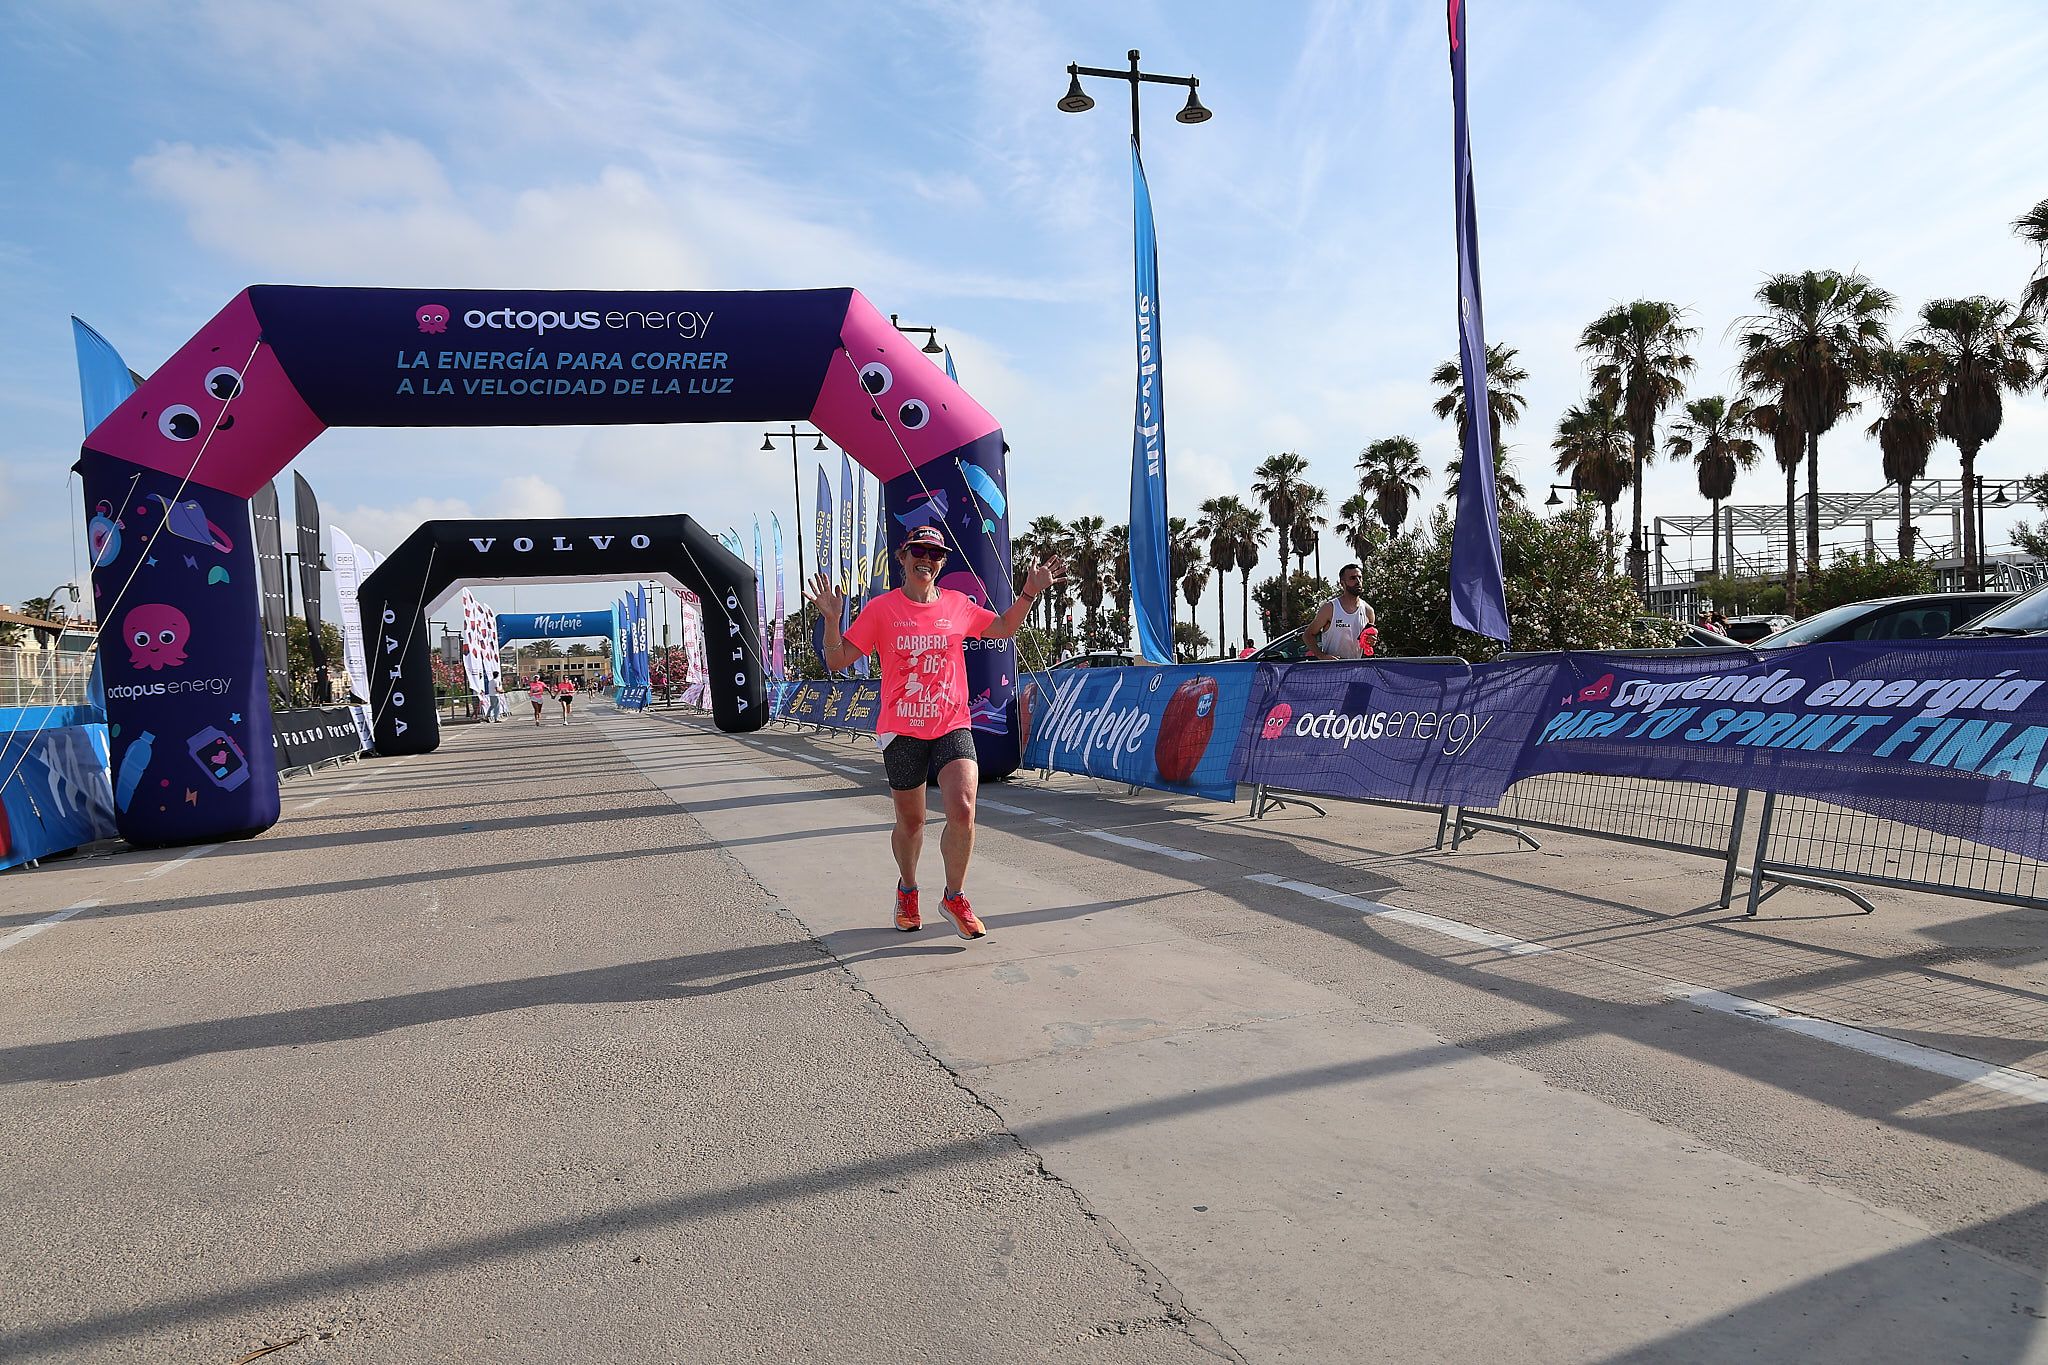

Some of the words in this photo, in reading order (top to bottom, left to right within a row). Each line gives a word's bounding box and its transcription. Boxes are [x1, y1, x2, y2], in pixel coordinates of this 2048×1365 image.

[464, 308, 600, 335] octopus
[605, 311, 713, 338] energy
[397, 351, 429, 369] LA
[438, 347, 549, 369] ENERGÍA
[556, 352, 623, 370] PARA
[631, 352, 728, 370] CORRER
[396, 378, 414, 394] A
[422, 378, 454, 394] LA
[463, 378, 606, 394] VELOCIDAD
[613, 379, 645, 394] DE
[651, 378, 680, 394] LA
[688, 377, 733, 394] LUZ
[468, 534, 651, 553] VOLVO
[534, 614, 582, 635] Marlene
[897, 635, 948, 650] CARRERA
[969, 638, 1008, 652] energy
[726, 595, 749, 714] VOLVO
[923, 655, 939, 674] DE
[382, 609, 408, 736] VOLVO
[108, 683, 166, 700] octopus
[167, 678, 232, 695] energy
[919, 689, 931, 703] LA
[1804, 669, 2046, 718] energía
[897, 703, 939, 718] MUJER
[1036, 672, 1150, 770] Marlene
[326, 722, 356, 738] VOLVO
[1296, 709, 1386, 749] octopus
[1386, 711, 1493, 756] energy
[1535, 709, 1637, 746] PARA
[1625, 706, 1701, 740] TU
[1684, 708, 1893, 753] SPRINT
[1872, 715, 2048, 790] FINA
